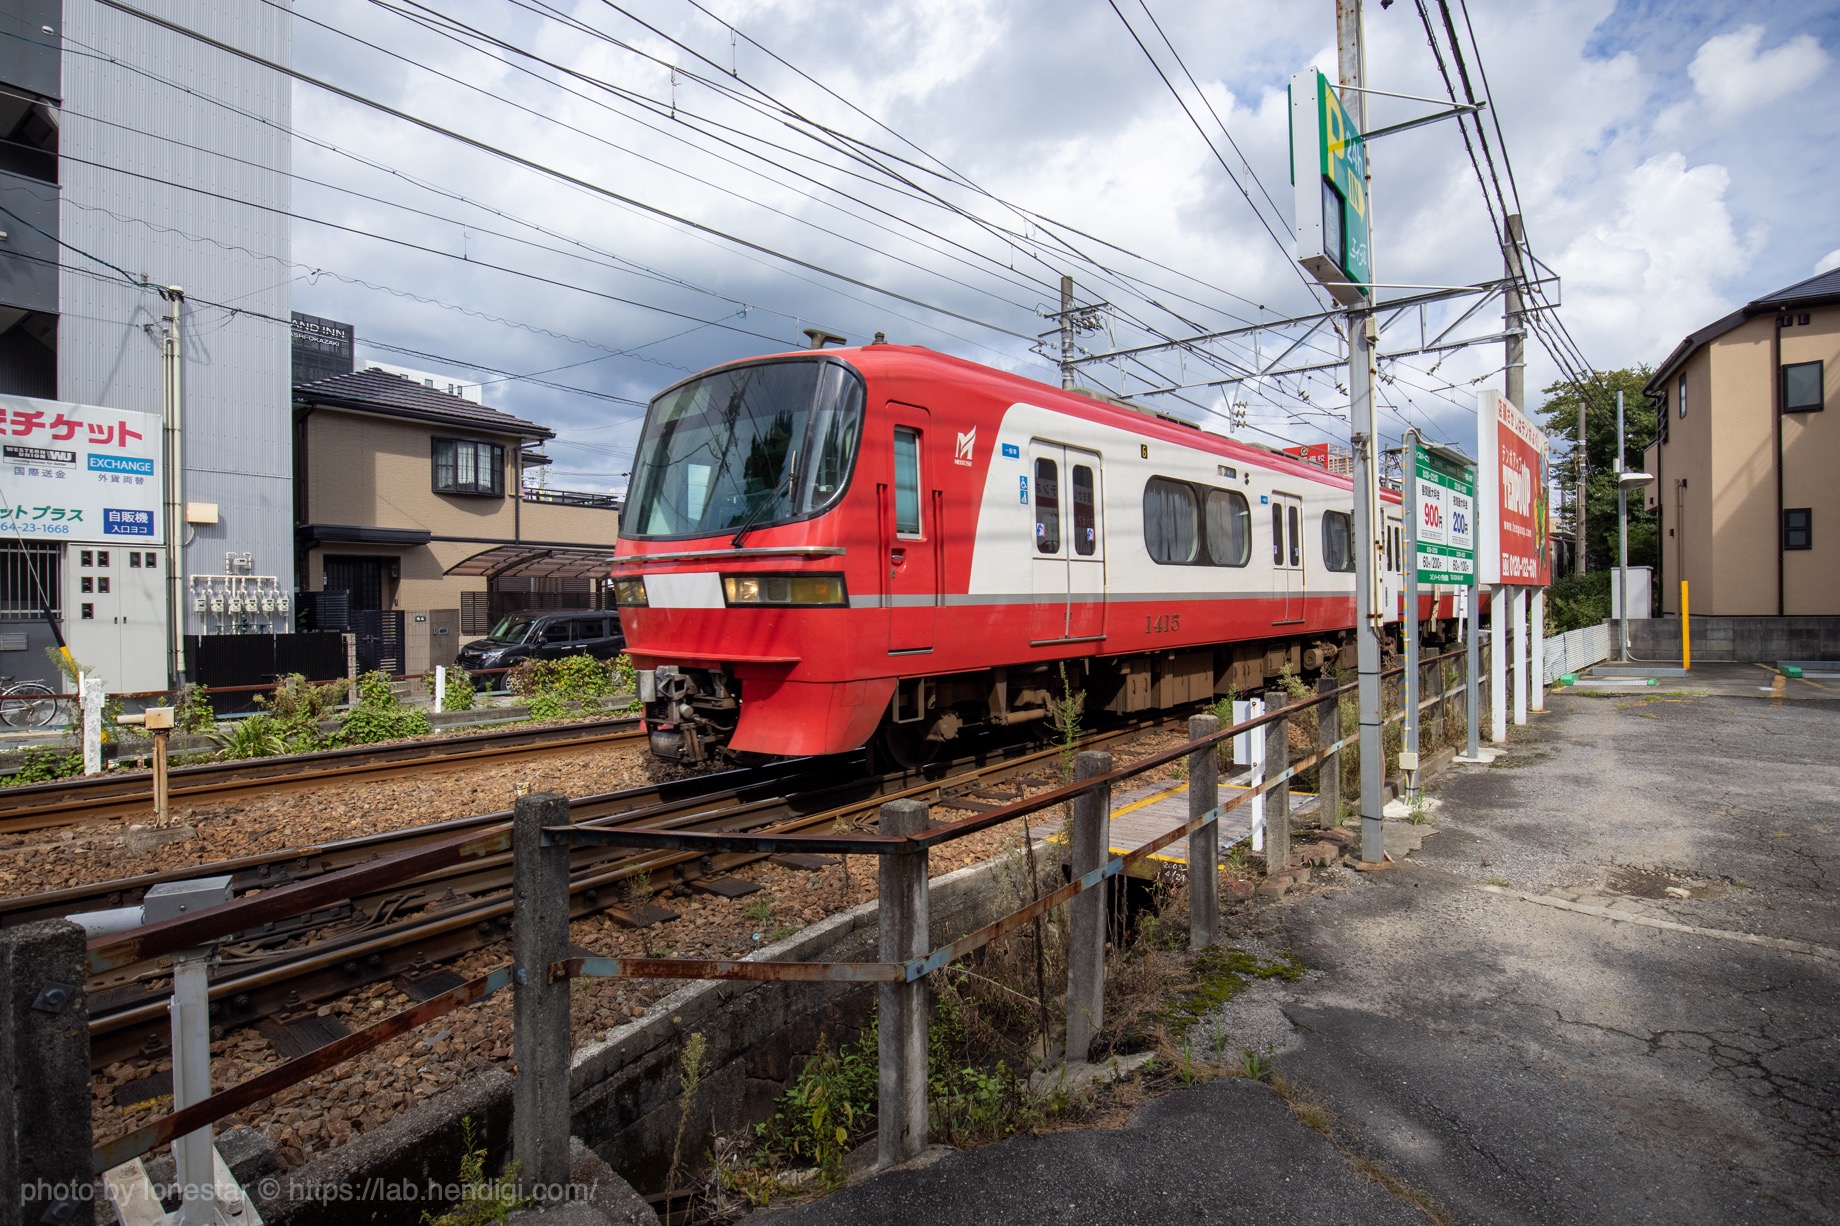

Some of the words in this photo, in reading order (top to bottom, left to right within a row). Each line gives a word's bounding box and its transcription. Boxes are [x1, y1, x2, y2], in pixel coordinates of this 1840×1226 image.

[322, 326, 345, 338] INN
[0, 408, 142, 447] チケット
[1142, 446, 1147, 458] 6
[90, 457, 152, 472] EXCHANGE
[14, 466, 66, 479] 国際送金
[98, 473, 145, 485] 外貨両替
[109, 510, 148, 524] 自販機
[111, 524, 147, 534] 入口ヨコ
[1145, 614, 1180, 633] 1415
